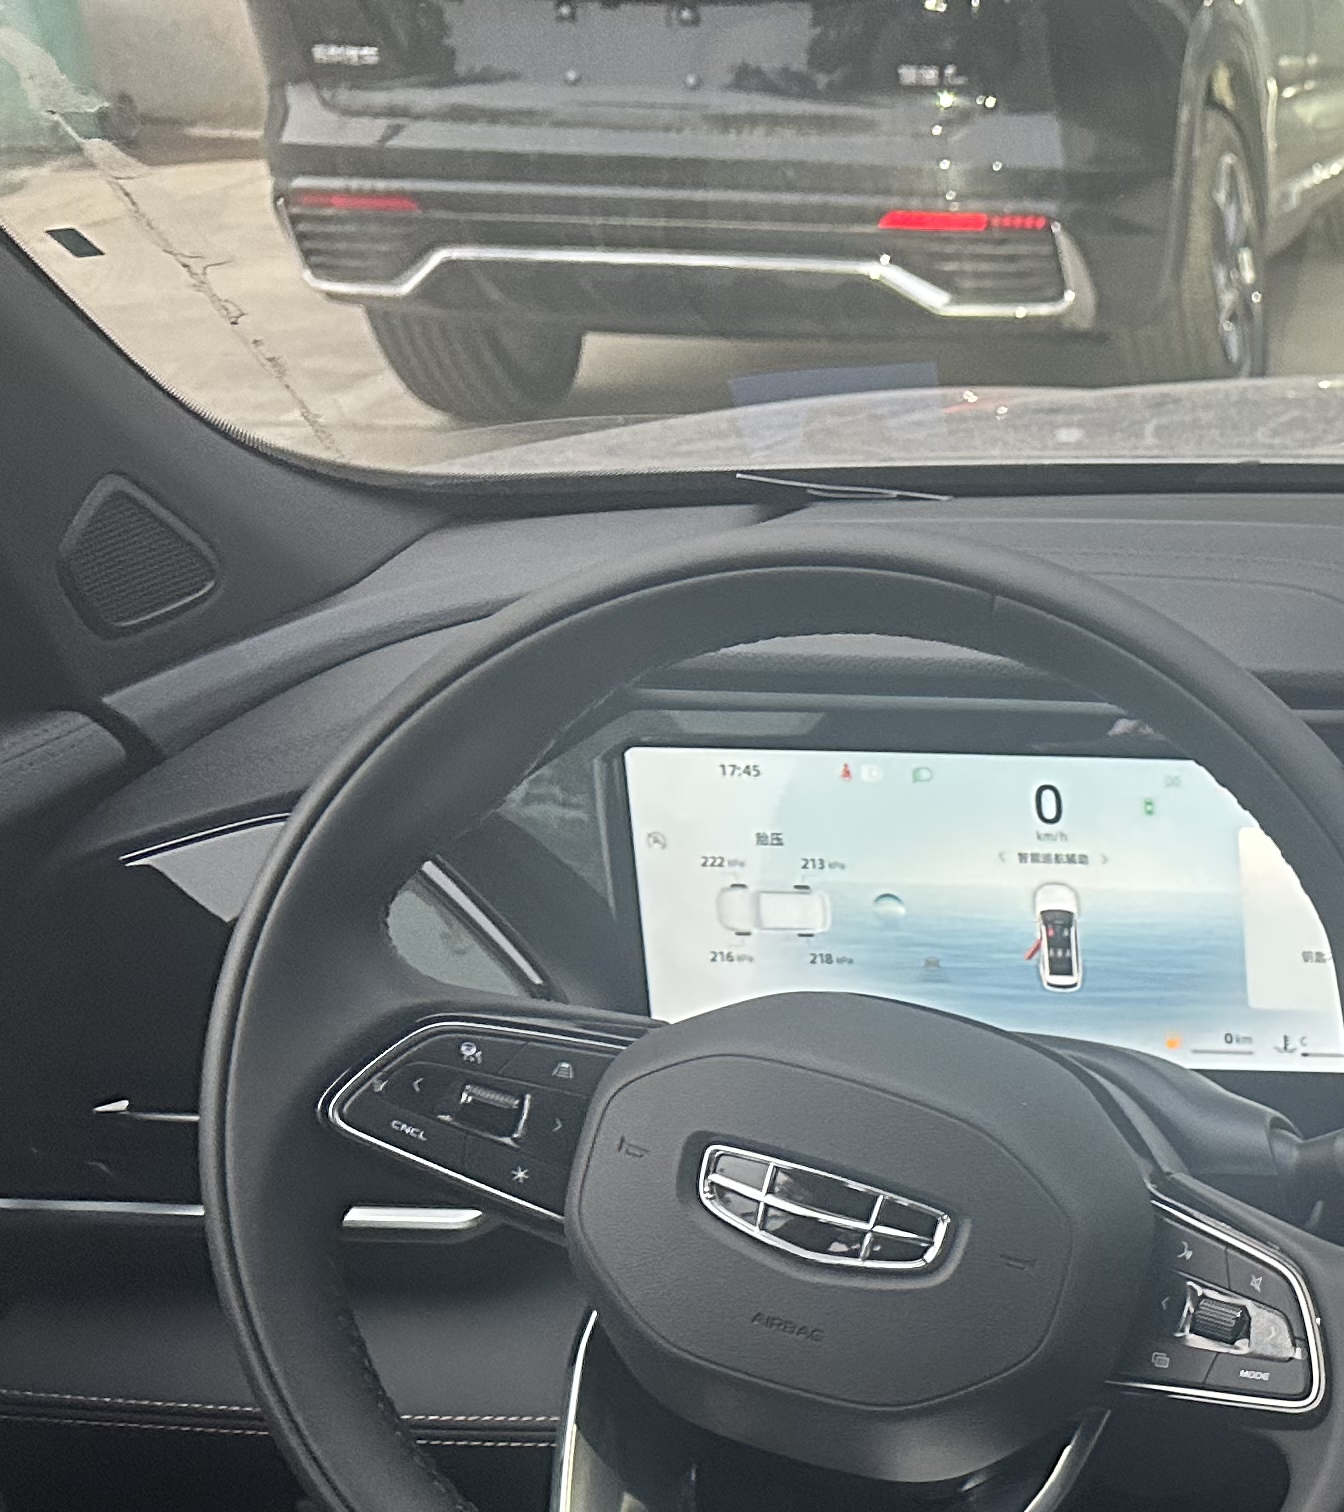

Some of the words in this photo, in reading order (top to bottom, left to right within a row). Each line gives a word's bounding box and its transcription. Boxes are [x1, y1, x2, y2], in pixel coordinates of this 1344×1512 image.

[719, 764, 761, 777] 17:45
[1034, 784, 1063, 825] 0
[1036, 831, 1068, 842] km/h
[700, 856, 725, 868] 222
[801, 858, 825, 870] 213
[710, 951, 734, 963] 216
[809, 953, 834, 965] 218
[1224, 1033, 1233, 1044] 0
[1235, 1034, 1253, 1044] km
[391, 1119, 428, 1141] CNCL
[751, 1309, 827, 1342] AIRBAG
[1239, 1369, 1270, 1381] MODE
